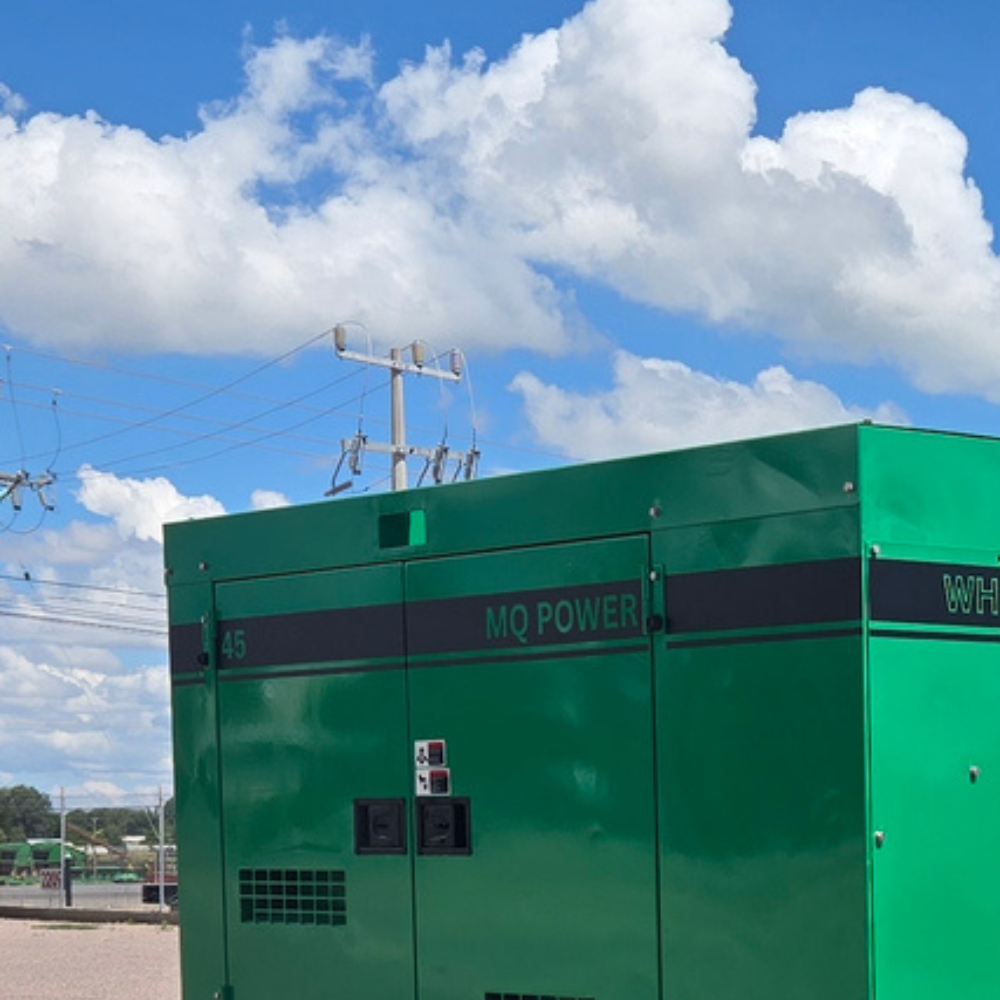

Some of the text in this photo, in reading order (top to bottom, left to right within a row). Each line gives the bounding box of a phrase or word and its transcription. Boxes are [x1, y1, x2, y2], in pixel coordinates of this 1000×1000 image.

[486, 594, 638, 644] MQ POWER
[222, 630, 246, 659] 45
